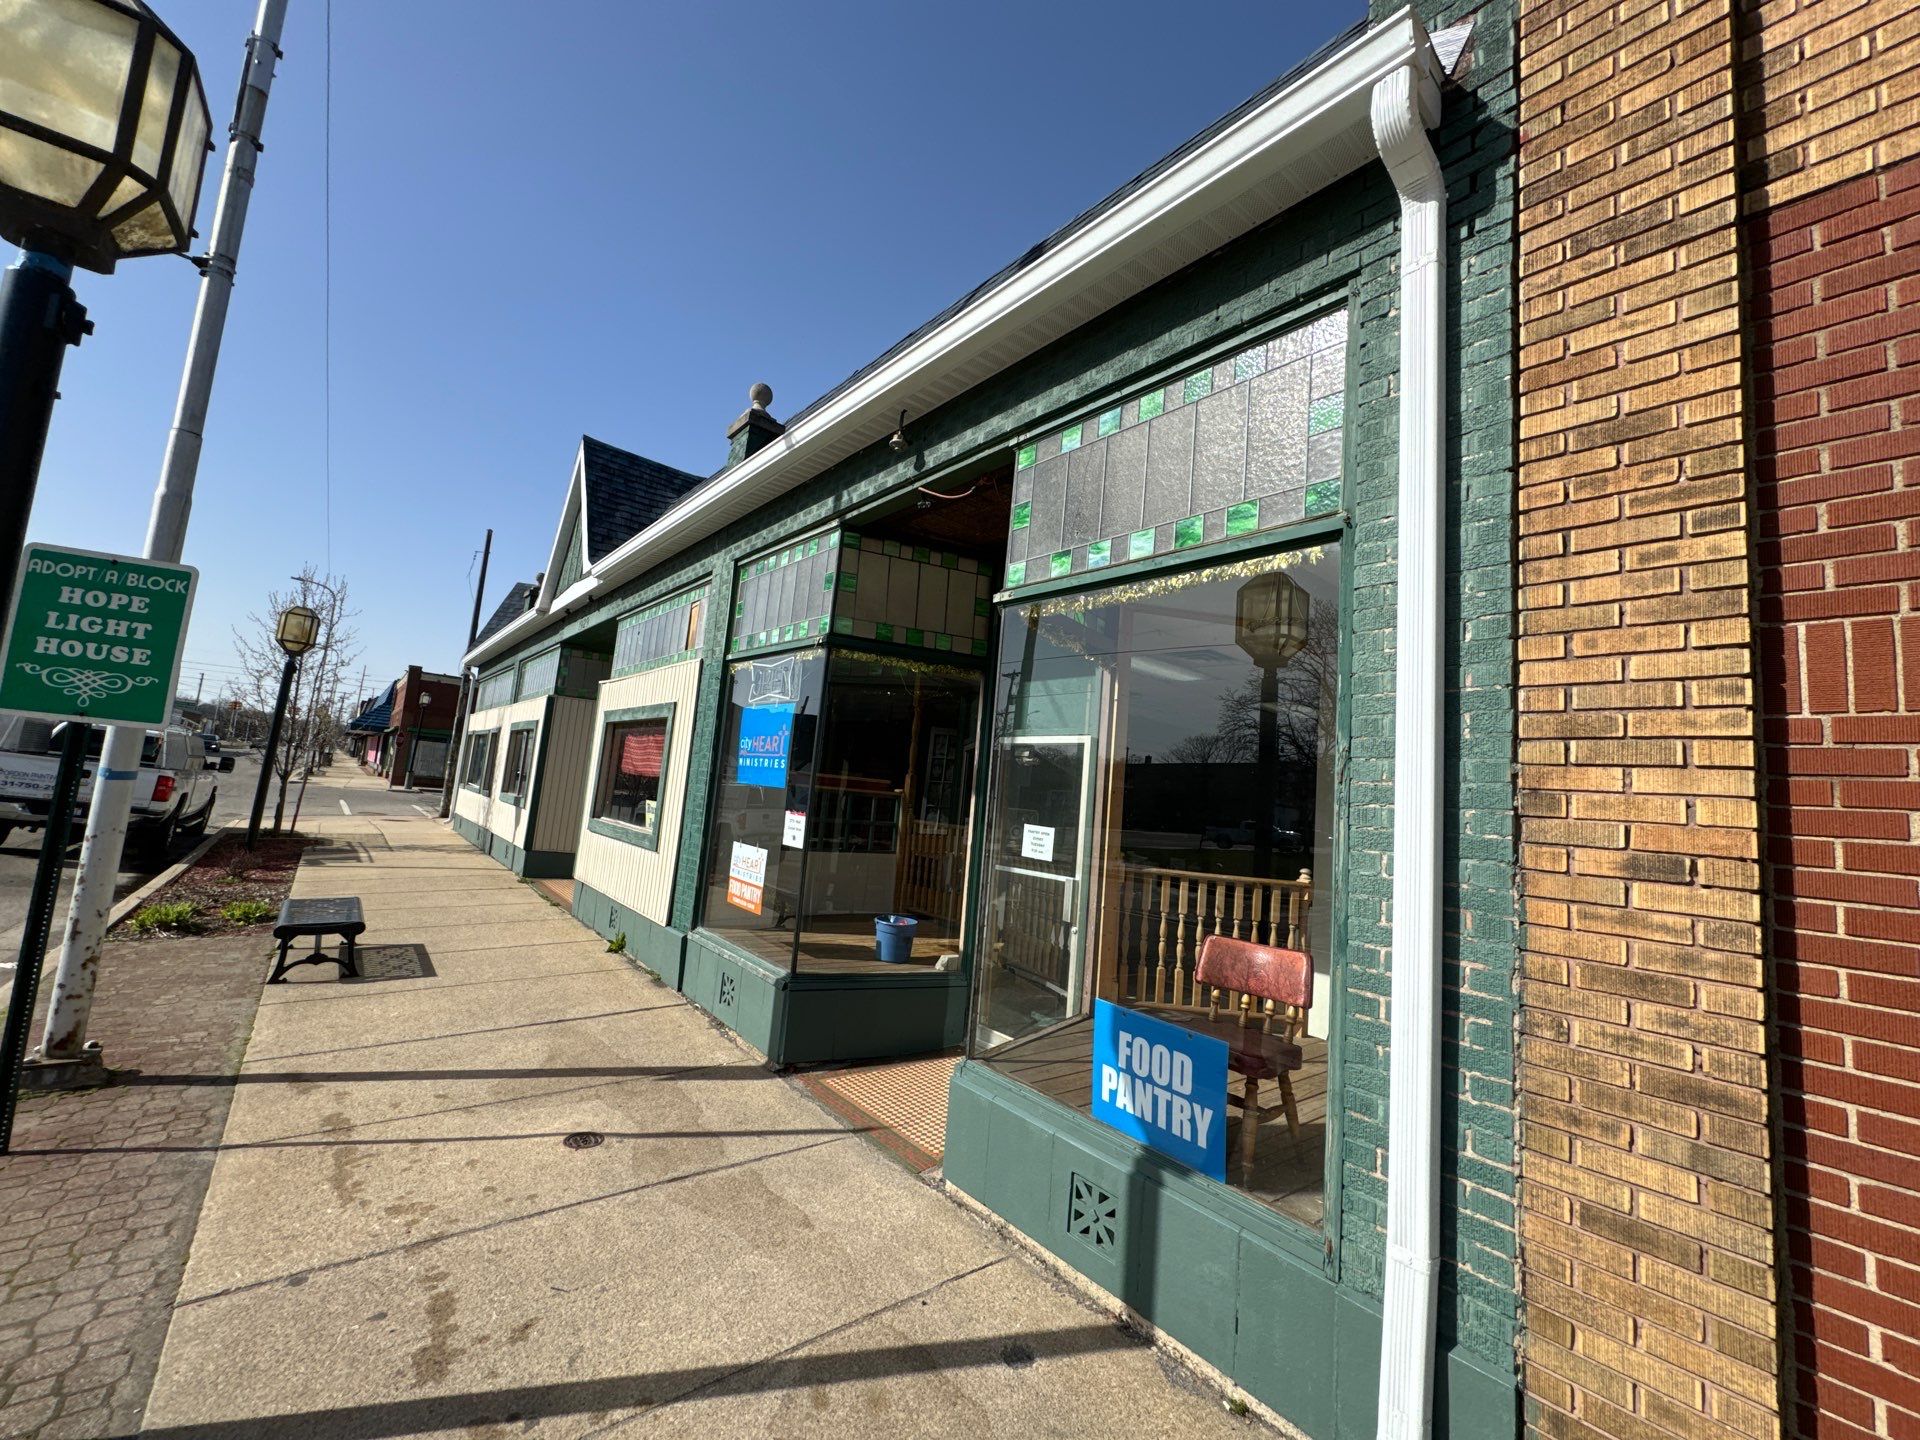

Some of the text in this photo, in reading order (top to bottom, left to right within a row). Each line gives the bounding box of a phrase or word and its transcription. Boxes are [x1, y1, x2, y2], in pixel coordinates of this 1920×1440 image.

[28, 558, 188, 594] ADOPT A BLOCK
[58, 586, 150, 614] HOPE
[45, 611, 152, 640] LIGHT
[34, 636, 151, 666] HOUSE
[739, 757, 786, 769] MINISTRIES
[1118, 1030, 1193, 1096] FOOD
[1101, 1063, 1214, 1150] PANTRY
